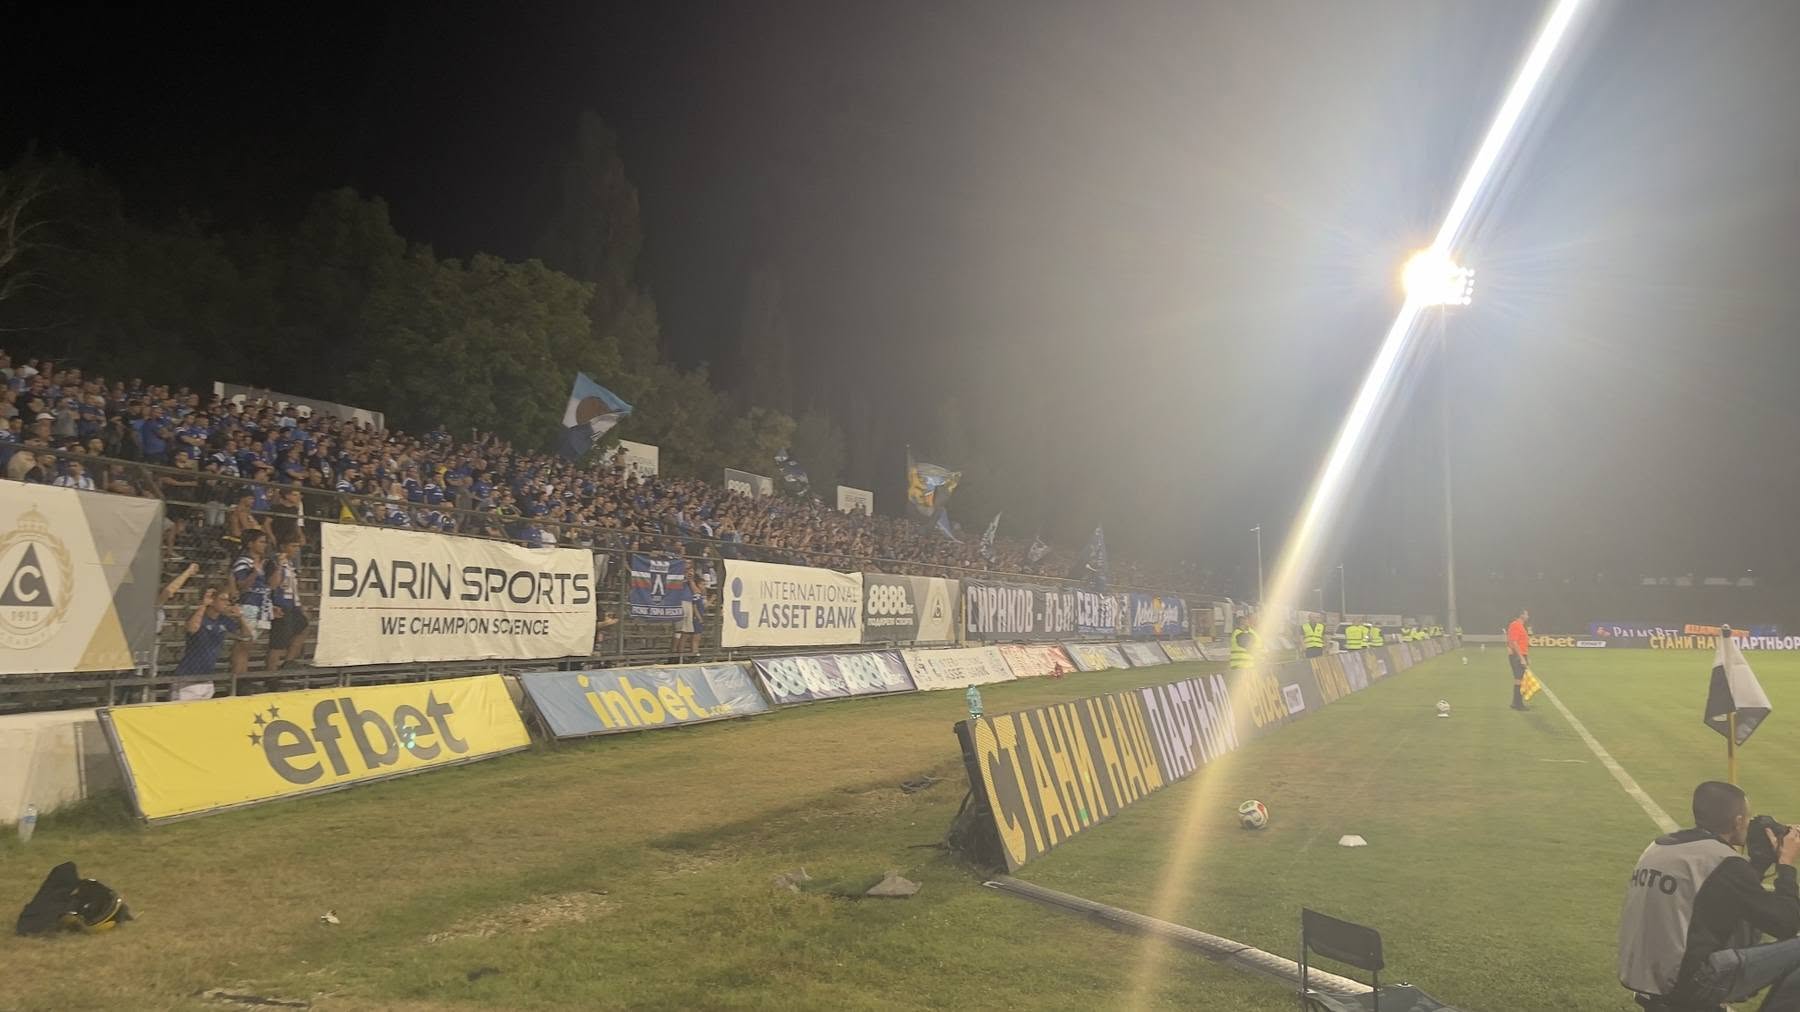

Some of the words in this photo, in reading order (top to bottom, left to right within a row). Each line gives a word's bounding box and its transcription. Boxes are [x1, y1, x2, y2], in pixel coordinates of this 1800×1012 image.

[329, 556, 451, 600] BARIN
[460, 566, 591, 605] SPORTS
[760, 581, 858, 603] INTERNATIONAL
[758, 603, 811, 628] ASSET
[815, 605, 857, 628] BANK
[967, 586, 1033, 632] СИРАКОВ
[381, 617, 405, 635] WE
[410, 616, 489, 635] CHAMPION
[492, 618, 549, 635] SCIENCE
[1528, 636, 1576, 648] efbet
[1650, 636, 1694, 650] СТАНИ
[263, 688, 469, 785] efbet
[975, 702, 1109, 866] СТАНИ
[1087, 690, 1164, 808] НАШ
[1632, 868, 1677, 895] HOTO
